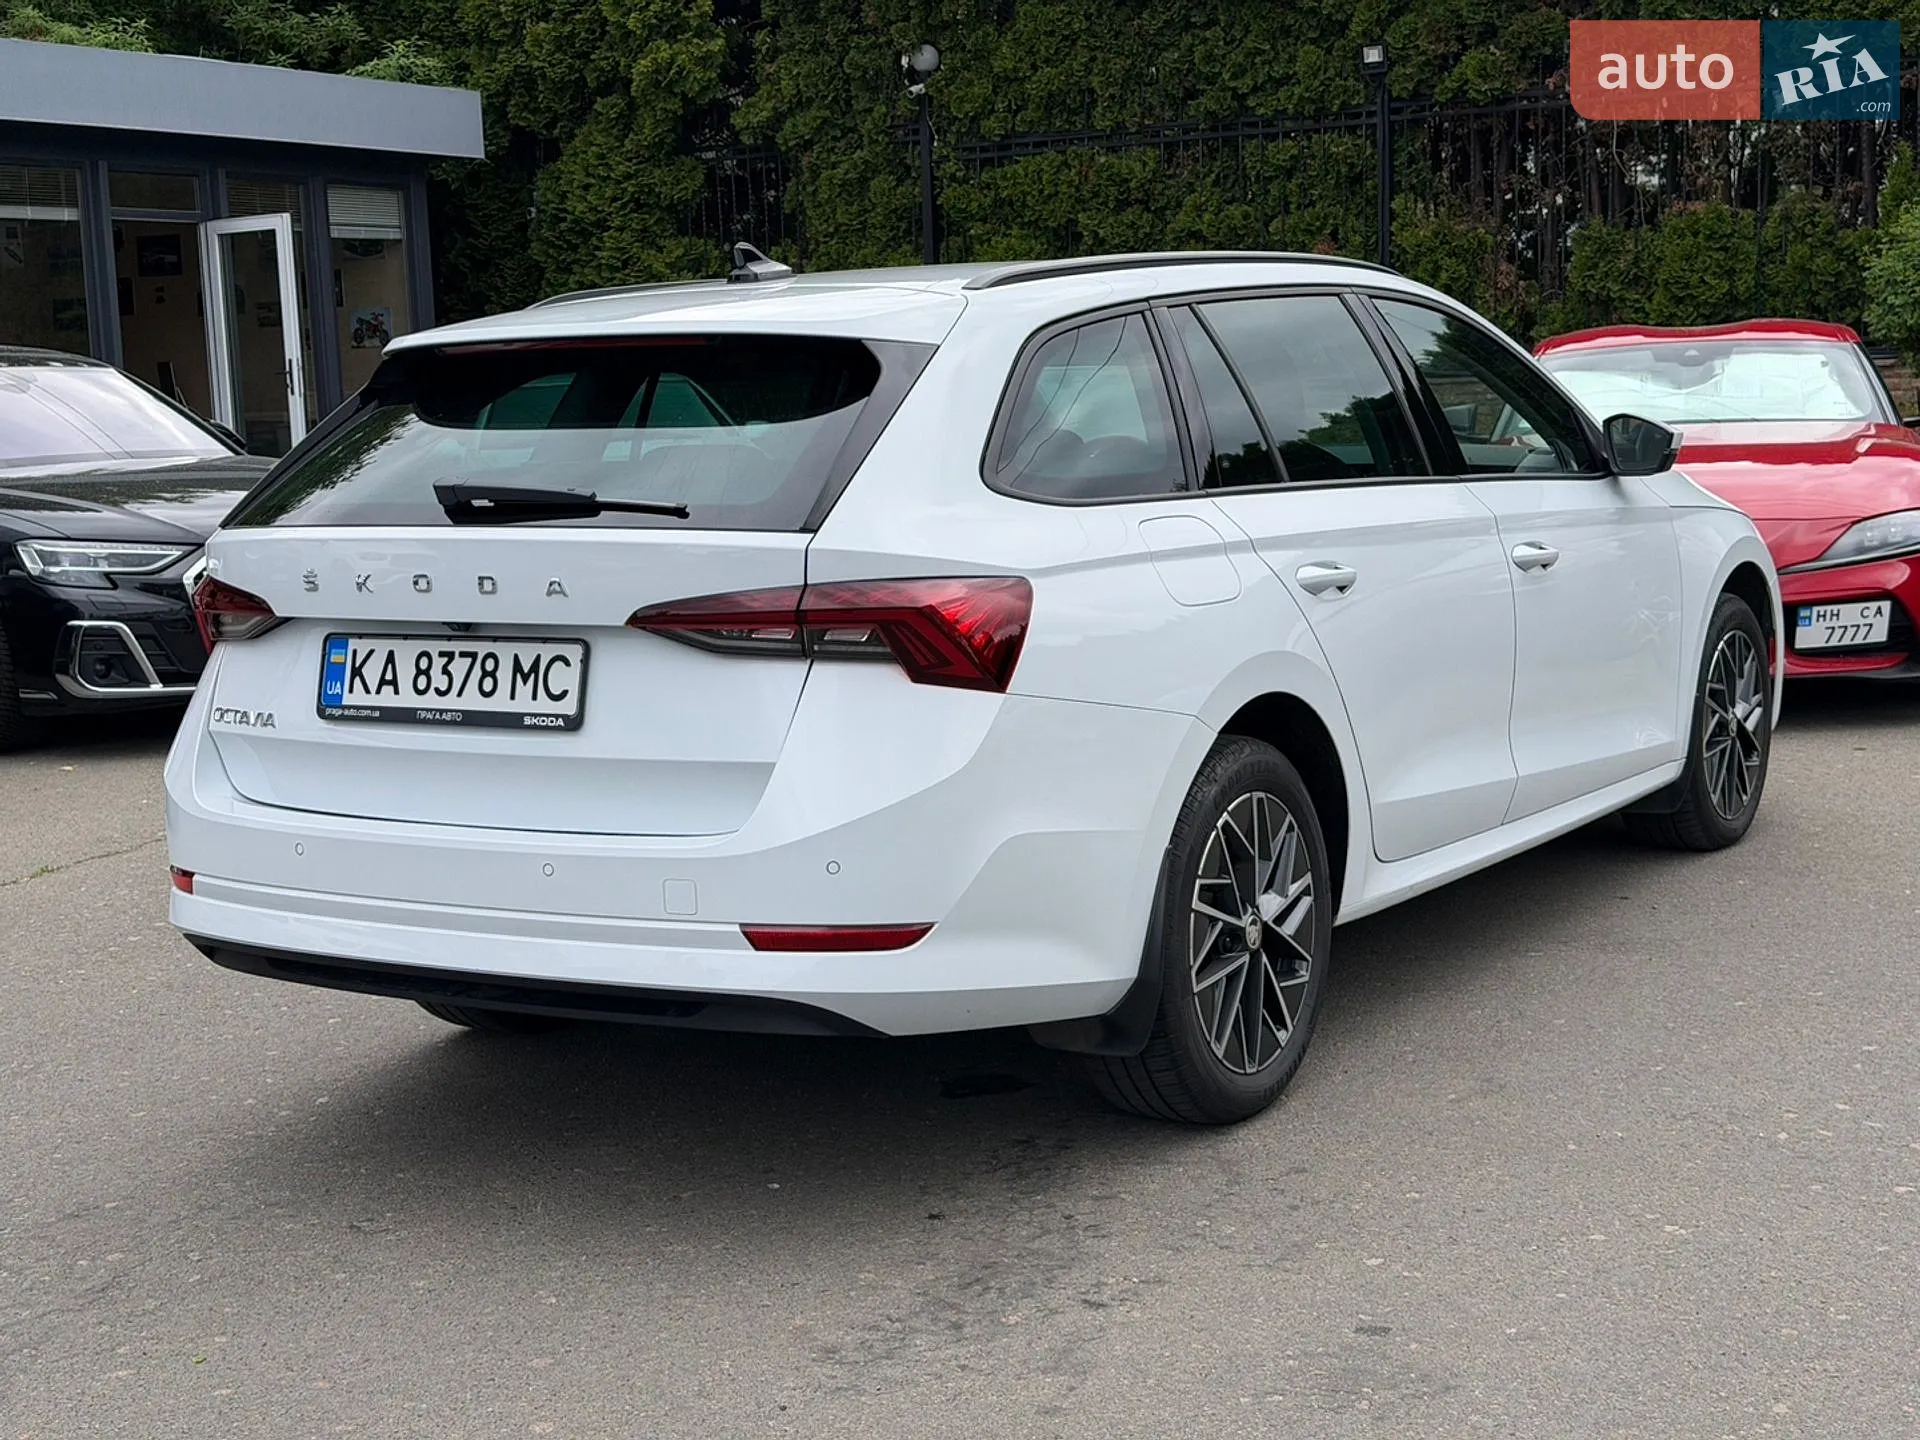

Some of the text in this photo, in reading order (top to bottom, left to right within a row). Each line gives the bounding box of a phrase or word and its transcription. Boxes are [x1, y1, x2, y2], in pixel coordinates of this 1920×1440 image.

[1815, 608, 1840, 623] HH
[1860, 605, 1883, 619] CA
[1824, 623, 1873, 644] 7777
[348, 647, 572, 702] KA 8378 MC
[326, 680, 342, 695] UA
